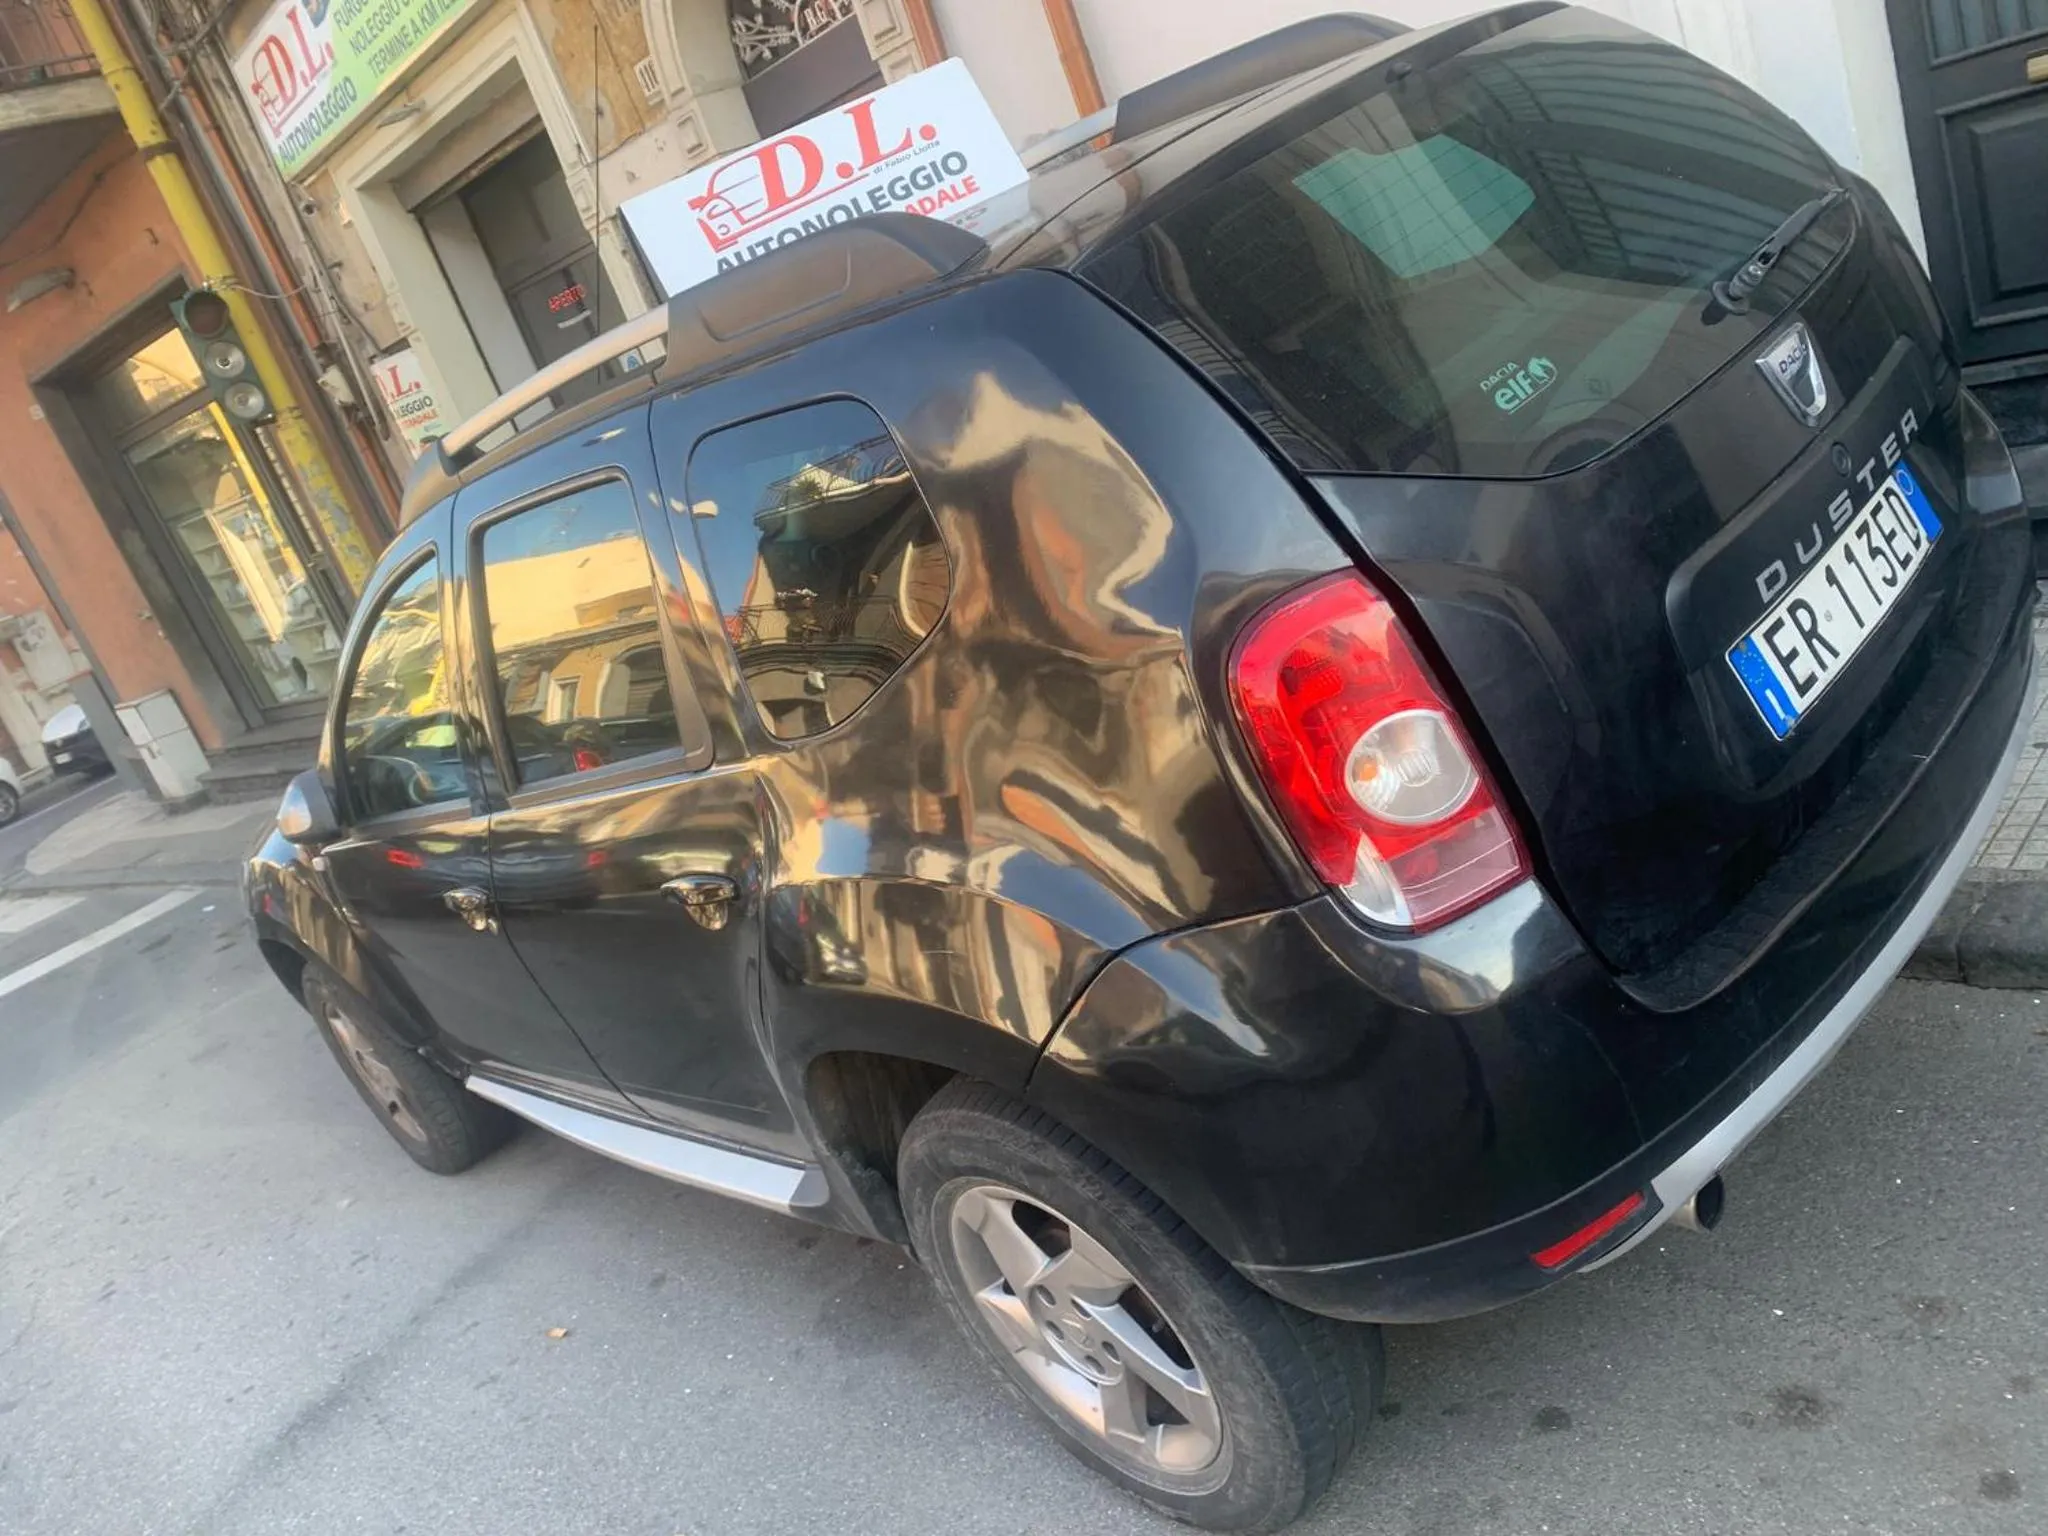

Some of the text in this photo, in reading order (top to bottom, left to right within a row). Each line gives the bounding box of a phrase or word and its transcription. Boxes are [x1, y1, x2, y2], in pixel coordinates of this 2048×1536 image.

[349, 0, 401, 57] NOLEGGIO
[368, 25, 414, 78] TERMINE
[410, 18, 424, 39] A
[278, 76, 358, 168] AUTONOLEGGIO
[1480, 362, 1518, 391] DACIA
[1495, 370, 1534, 410] elf
[1756, 407, 1919, 603] DUSTER
